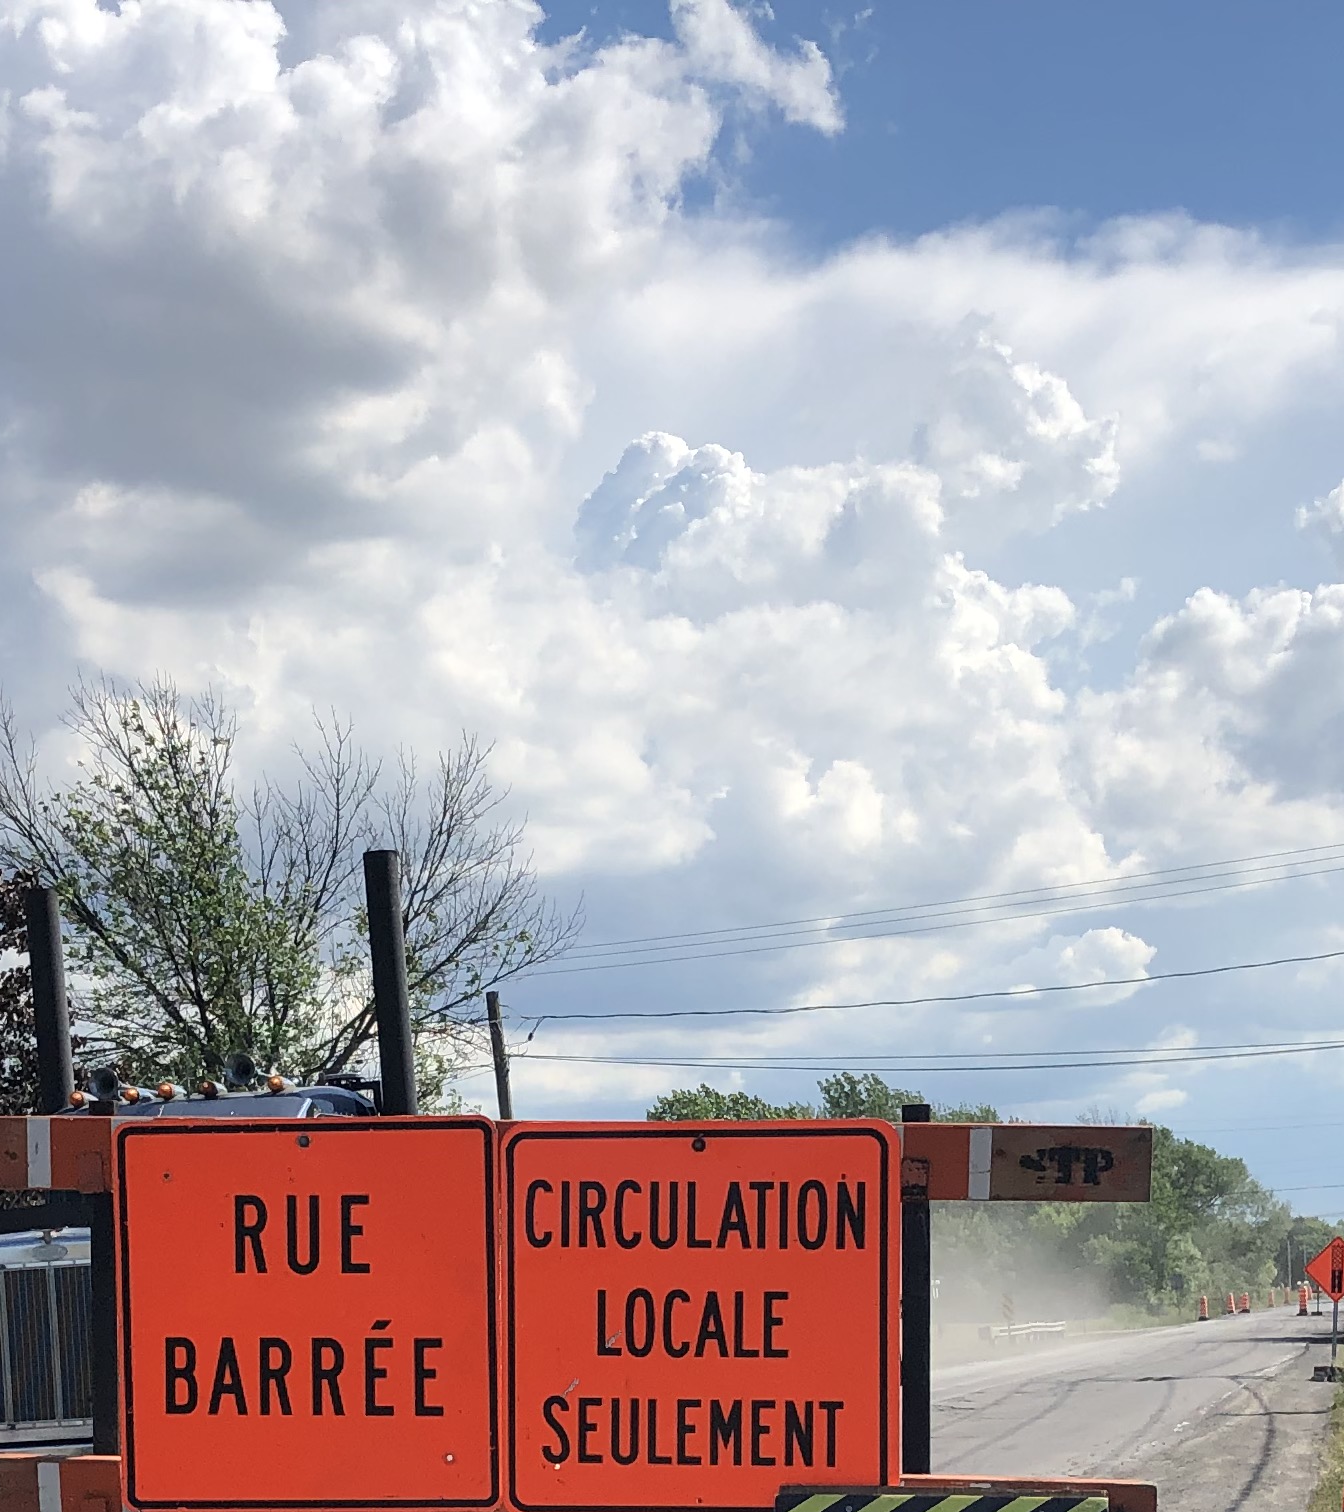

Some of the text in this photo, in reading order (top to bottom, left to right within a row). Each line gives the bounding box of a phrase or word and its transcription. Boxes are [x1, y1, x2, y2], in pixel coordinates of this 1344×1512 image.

[234, 1195, 370, 1275] RUE
[525, 1180, 865, 1250] CIRCULATION
[596, 1287, 789, 1358] LOCALE
[165, 1319, 444, 1416] BARRÉE
[542, 1395, 844, 1467] SEULEMENT
